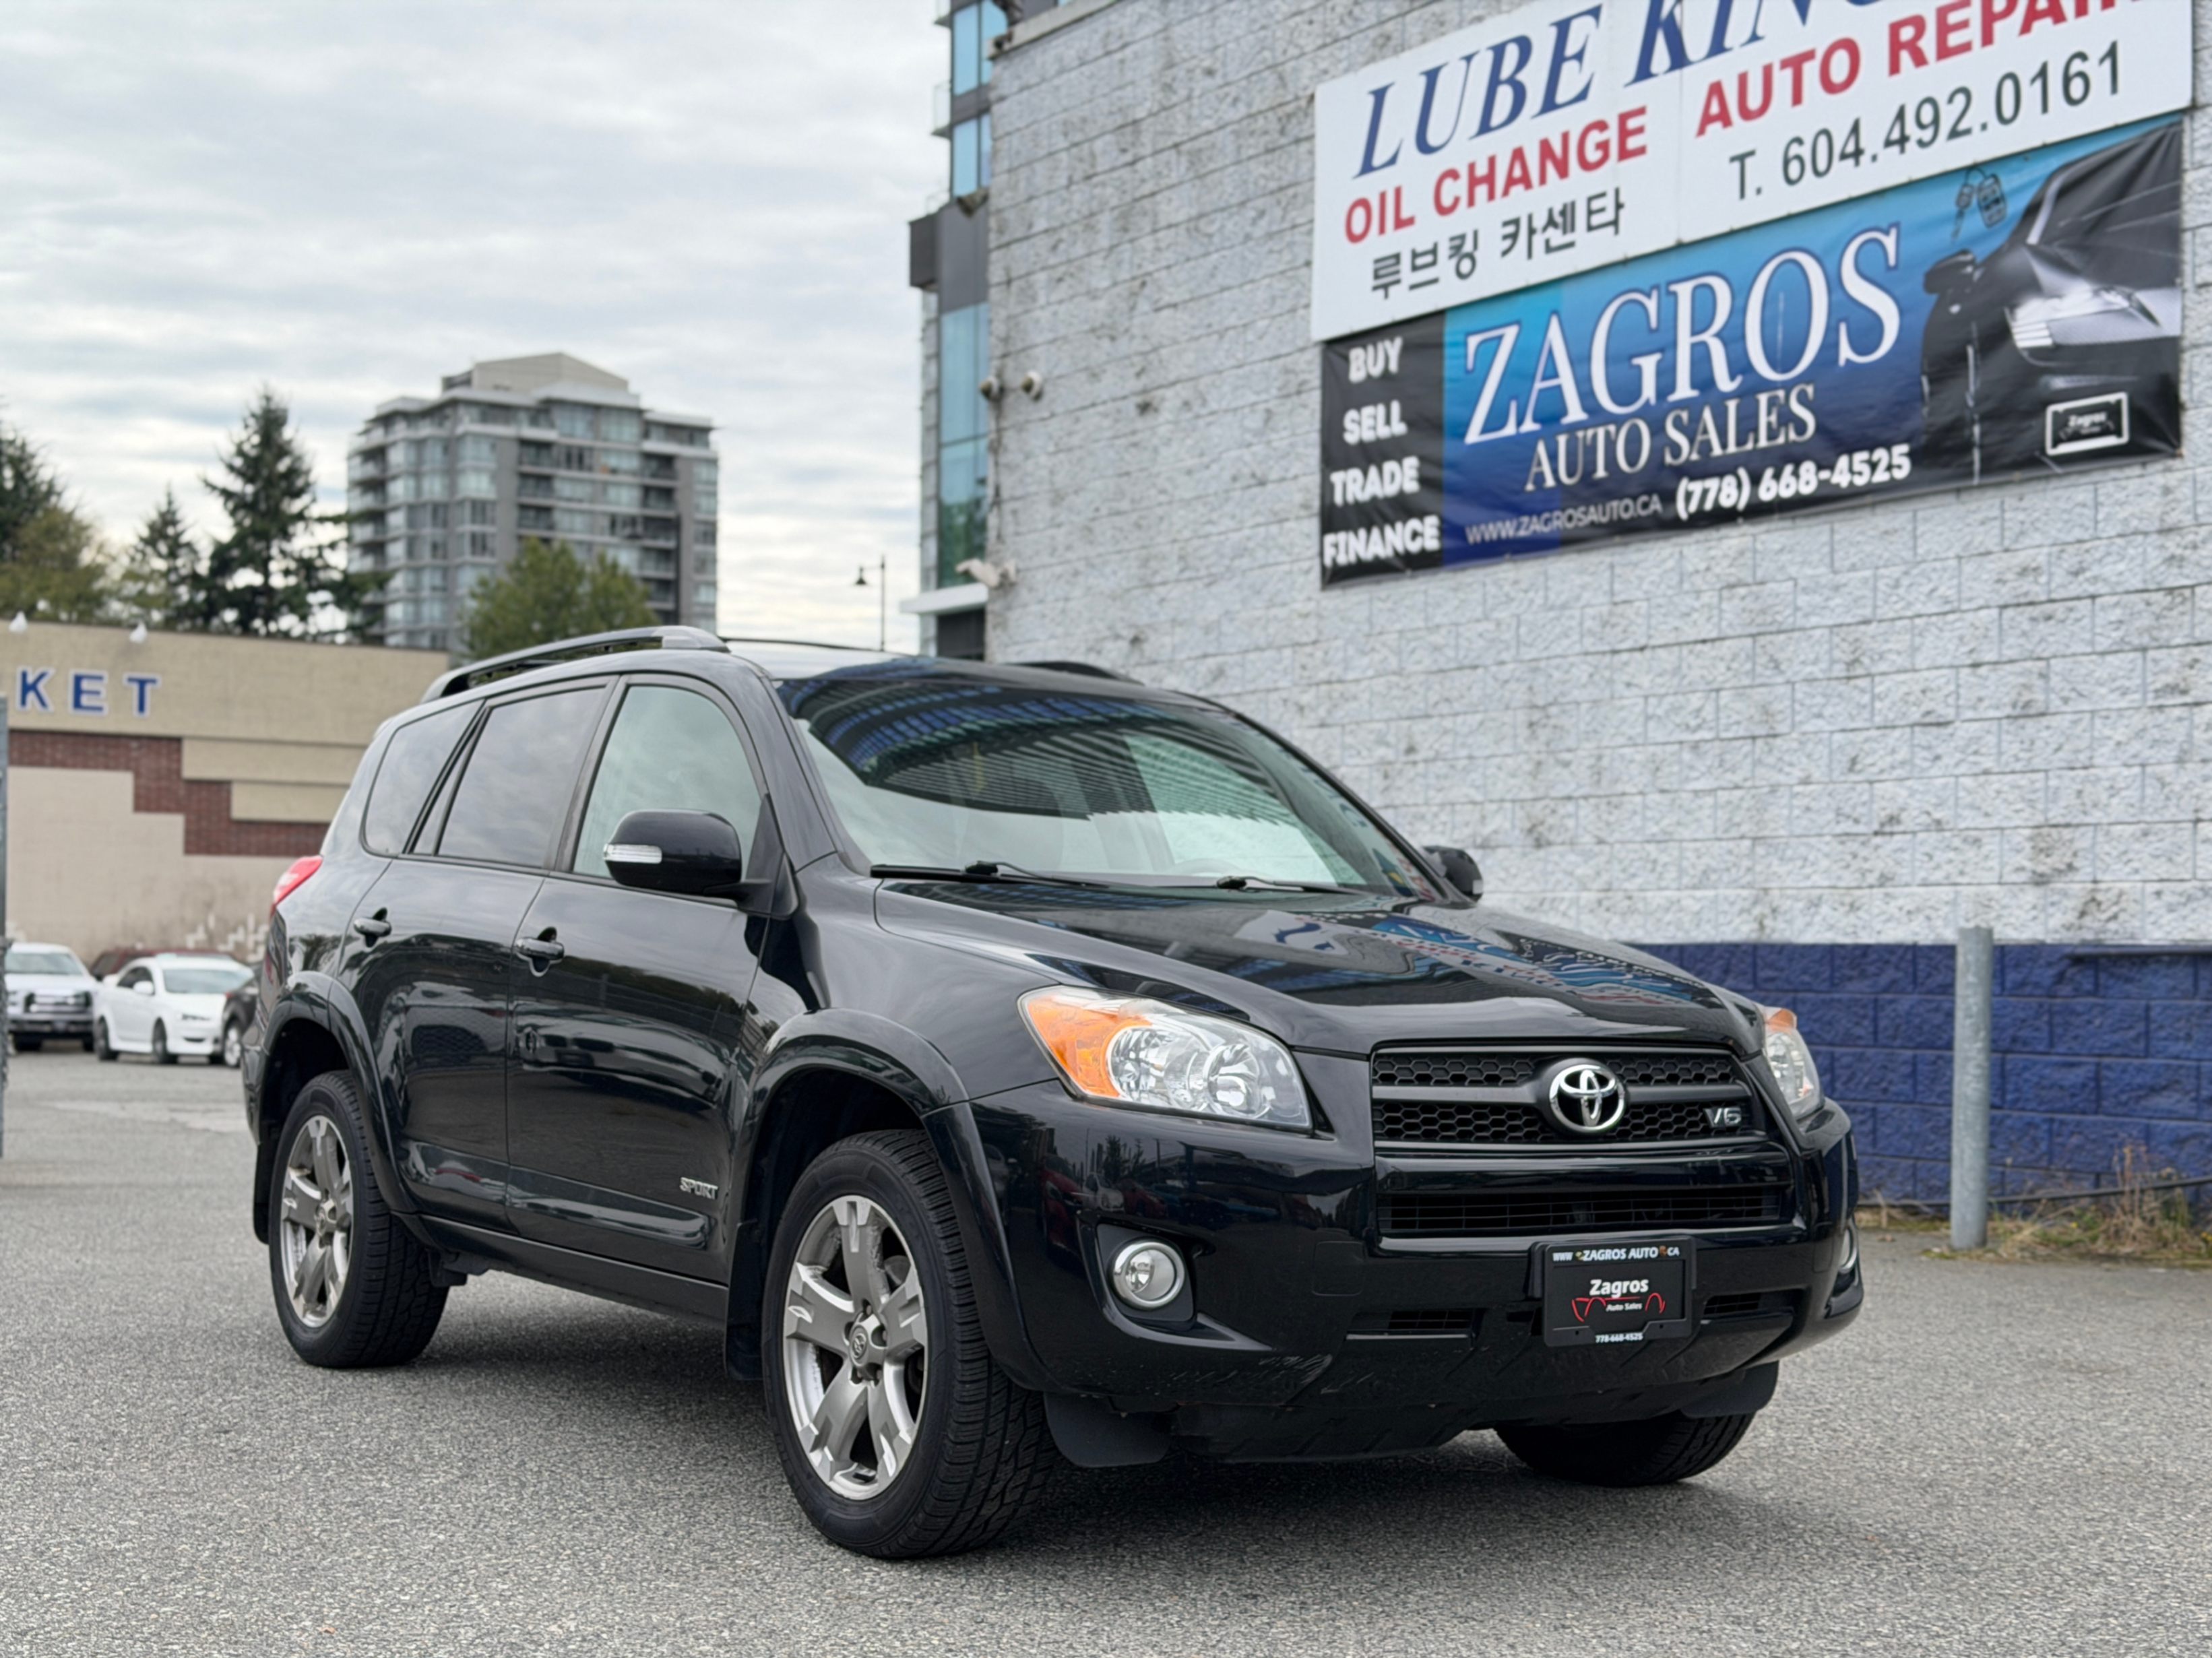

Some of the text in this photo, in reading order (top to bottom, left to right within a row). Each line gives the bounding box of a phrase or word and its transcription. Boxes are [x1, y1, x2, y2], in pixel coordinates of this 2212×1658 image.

[1352, 0, 1888, 180] LUBE KI
[1695, 0, 2145, 138] AUTO REPA
[1729, 40, 2120, 200] T. 604.492.0161
[1344, 106, 1647, 245] OIL CHANGE
[1372, 187, 1624, 300] 루브킹 카센타
[1348, 337, 1403, 383] BUY
[1464, 225, 1902, 445] ZAGROS
[1343, 400, 1408, 445] SELL
[1524, 383, 1816, 492] AUTO SALES
[1330, 456, 1420, 507] TRADE
[1465, 443, 1911, 545] WWW.ZAGROSAUTO.CA (778) 668-4525
[1323, 515, 1442, 567] FINANCE
[18, 667, 161, 715] KET
[1703, 1106, 1742, 1128] V6
[679, 1176, 718, 1200] SPORT
[1583, 1248, 1626, 1261] ZAGROS
[1628, 1247, 1658, 1259] AUTO
[1667, 1246, 1680, 1256] CA
[1589, 1279, 1649, 1299] Zagros
